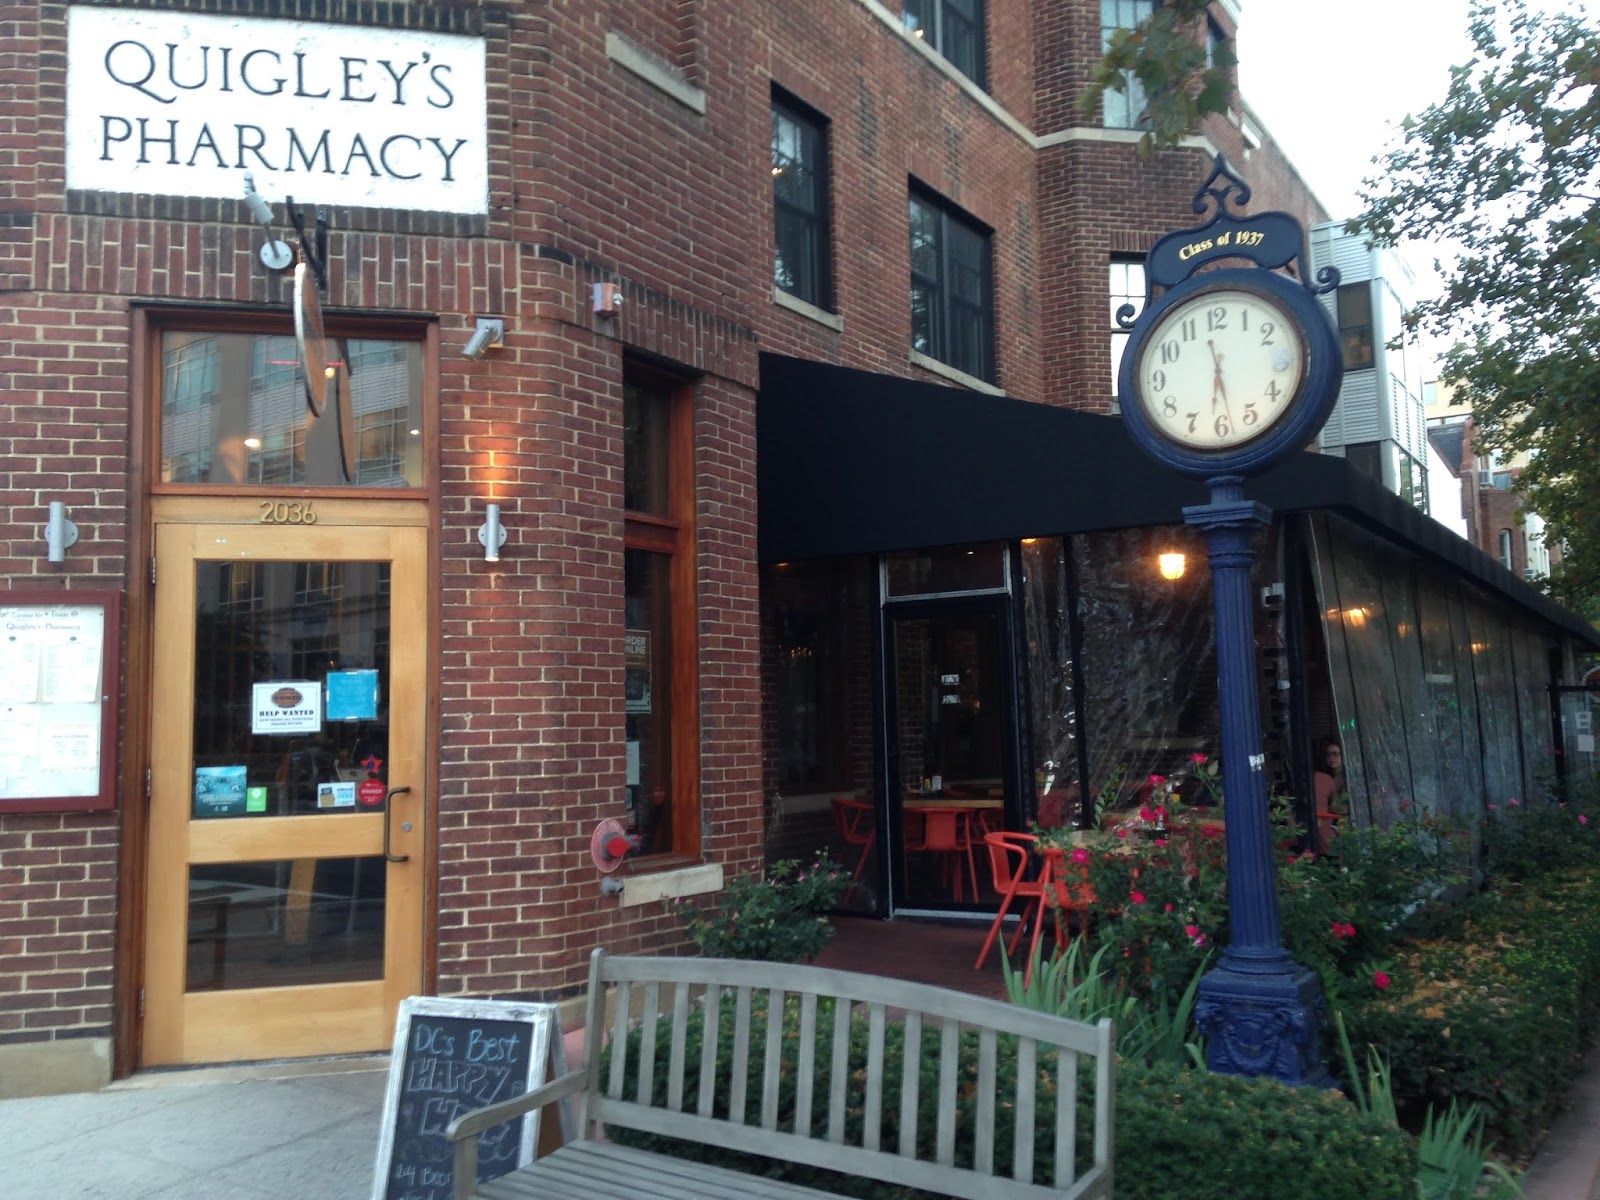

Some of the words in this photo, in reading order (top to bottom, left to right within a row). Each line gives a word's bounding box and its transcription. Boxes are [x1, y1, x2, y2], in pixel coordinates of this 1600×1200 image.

[104, 39, 454, 109] QUIGLEY'S
[98, 114, 468, 182] PHARMACY
[1179, 239, 1213, 261] Class
[1216, 231, 1232, 246] of
[1235, 230, 1265, 247] 1937
[1181, 317, 1197, 342] 11
[1206, 306, 1228, 332] 12
[1241, 308, 1249, 331] 1
[1260, 322, 1276, 346] 2
[1161, 340, 1181, 364] 10
[1152, 369, 1166, 392] 9
[1264, 379, 1281, 402] 4
[1163, 395, 1178, 418] 8
[1242, 402, 1259, 426] 5
[1185, 411, 1200, 434] 7
[1214, 414, 1229, 438] 6
[260, 500, 317, 525] 2036
[625, 635, 646, 646] RDER
[625, 645, 647, 655] NLINE
[466, 1029, 521, 1063] Best
